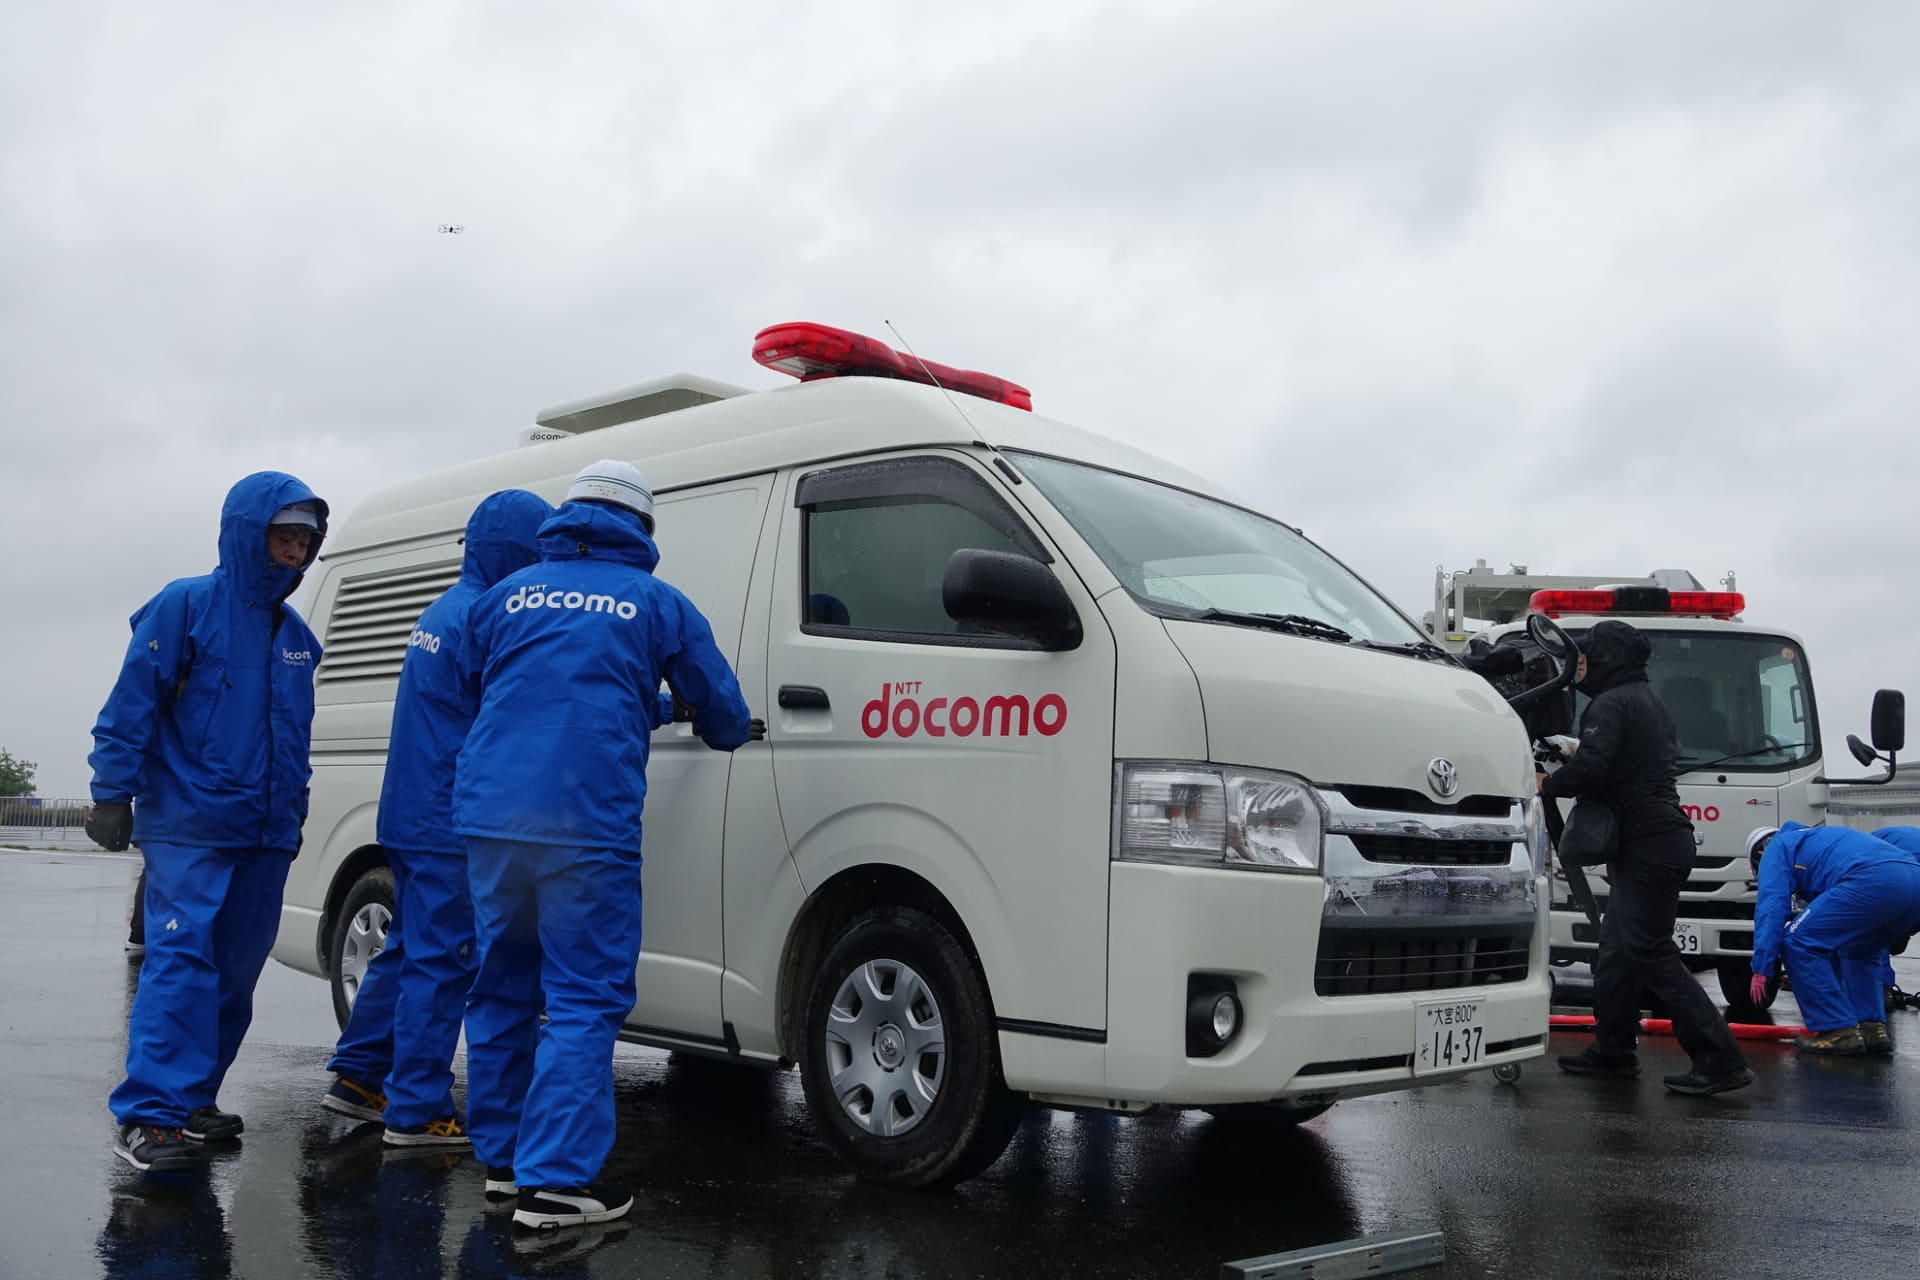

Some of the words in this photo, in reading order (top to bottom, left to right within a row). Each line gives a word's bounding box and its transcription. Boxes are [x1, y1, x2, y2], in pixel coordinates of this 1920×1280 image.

[528, 584, 547, 592] NTT
[505, 586, 637, 619] docomo
[895, 681, 922, 695] NTT
[861, 683, 1067, 738] docomo
[1677, 935, 1698, 951] 39
